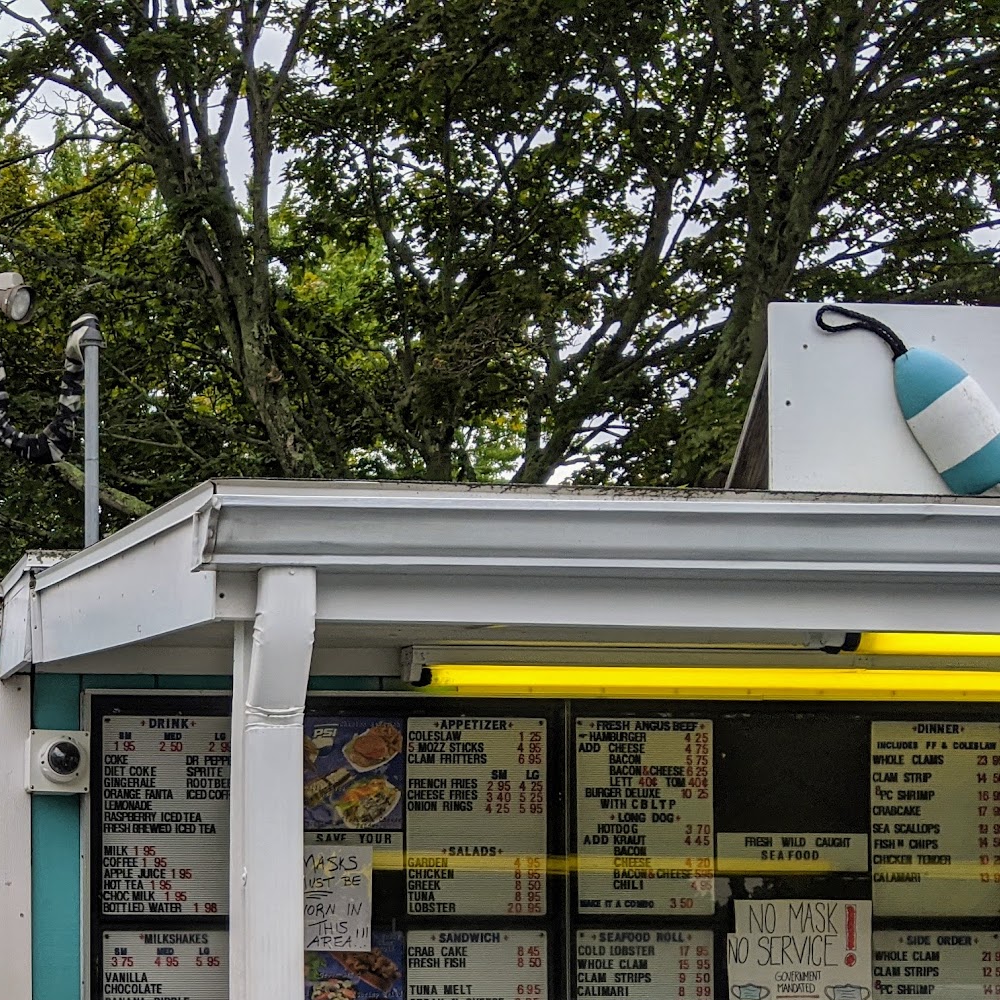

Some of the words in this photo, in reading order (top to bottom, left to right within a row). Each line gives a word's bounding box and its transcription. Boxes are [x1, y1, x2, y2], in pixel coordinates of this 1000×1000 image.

[149, 719, 189, 728] DRINK
[441, 720, 507, 730] APPETIZER
[597, 721, 630, 730] FRESH
[635, 721, 670, 730] ANGUS
[673, 722, 698, 731] BEEF
[918, 724, 959, 734] DINNER
[409, 731, 462, 741] COLESLAW
[590, 732, 646, 742] HAMBURGER
[104, 755, 128, 764] COKE
[408, 754, 435, 764] CLAM
[440, 754, 487, 764] FRITTERS
[104, 767, 126, 776] DIET
[129, 767, 156, 776] COKE
[186, 767, 222, 777] SPRITE
[104, 778, 155, 787] GINGERALE
[408, 779, 446, 788] FRENCH
[451, 779, 478, 788] FRIES
[104, 789, 140, 799] ORANGE
[145, 789, 173, 799] FANTA
[408, 790, 444, 800] CHEESE
[450, 790, 478, 800] FRIES
[585, 788, 622, 798] BURGER
[626, 788, 661, 798] DELUXE
[104, 801, 152, 810] LEMONADE
[408, 801, 437, 811] ONION
[443, 801, 473, 811] RINGS
[104, 812, 156, 821] RASPBERRY
[161, 812, 182, 822] ICED
[183, 812, 202, 822] TEA
[618, 813, 646, 822] LONG
[652, 813, 674, 823] DOG
[873, 824, 890, 834] SEA
[894, 824, 940, 834] SCALLOPS
[359, 834, 391, 844] YOUR
[745, 837, 773, 847] FRESH
[781, 837, 806, 848] WILD
[815, 838, 851, 848] CAUGHT
[104, 846, 128, 856] MILK
[449, 846, 496, 856] SALADS
[761, 850, 819, 860] SEAFOOD
[103, 857, 138, 867] COFFEE
[408, 858, 448, 867] GARDEN
[104, 869, 133, 878] APPLE
[138, 869, 166, 878] JUICE
[408, 869, 454, 879] CHICKEN
[341, 876, 361, 886] BE
[408, 880, 440, 890] GREEK
[103, 891, 129, 901] CHOC
[132, 891, 155, 901] MILK
[408, 892, 434, 901] TUNA
[104, 903, 144, 912] BOTTLED
[149, 903, 181, 912] WATER
[347, 902, 362, 916] IN
[410, 903, 456, 912] LOBSTER
[750, 902, 776, 934] NO
[789, 902, 838, 934] MASK
[308, 920, 348, 935] THIS
[144, 934, 208, 944] MILKSHAKES
[439, 933, 500, 943] SANDWICH
[600, 932, 650, 942] SEAFOOD
[657, 932, 684, 943] ROLL
[907, 936, 931, 945] SIDE
[937, 936, 972, 945] ORDER
[408, 946, 434, 956] CRAB
[441, 946, 468, 956] CAKE
[578, 946, 605, 956] COLD
[610, 946, 655, 956] LOBSTER
[728, 937, 749, 964] NO
[758, 935, 838, 966] SERVICE
[408, 958, 440, 968] FRESH
[444, 958, 466, 968] FISH
[578, 960, 614, 969] WHOLE
[620, 960, 648, 969] CLAM
[105, 973, 148, 982] VANILLA
[775, 971, 822, 982] GOVERNMENT
[105, 984, 162, 994] CHOCOLATE
[409, 985, 438, 995] TUNA
[444, 985, 472, 995] MELT
[777, 983, 815, 993] MANDATED
